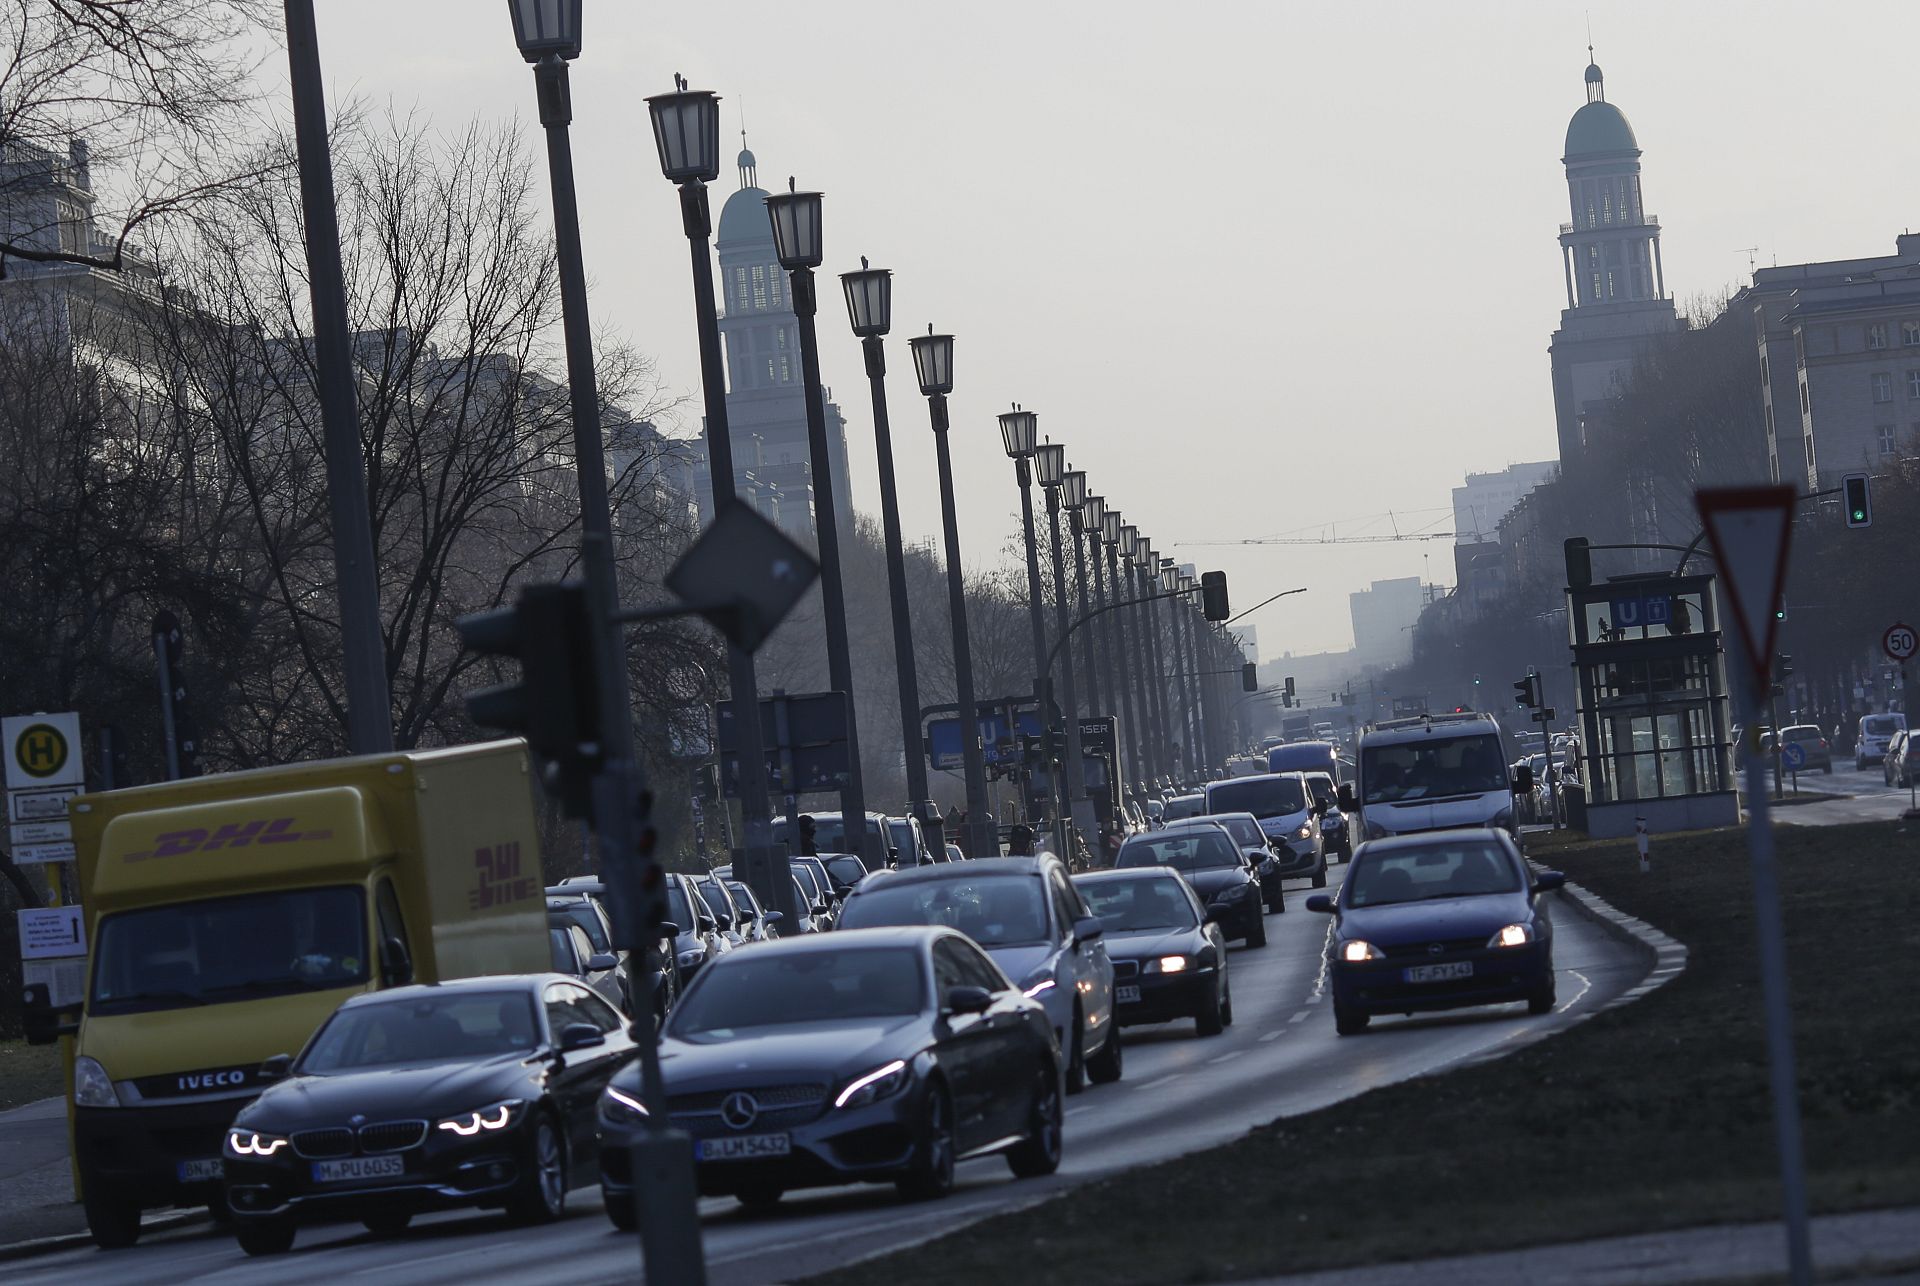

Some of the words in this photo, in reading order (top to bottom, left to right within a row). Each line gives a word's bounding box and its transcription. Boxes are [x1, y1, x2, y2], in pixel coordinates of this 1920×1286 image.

[1618, 601, 1638, 624] U
[1891, 633, 1912, 651] 50
[979, 720, 996, 745] U
[29, 735, 53, 765] H
[152, 817, 302, 858] DHL
[178, 1070, 244, 1091] IVECO
[320, 1163, 332, 1178] M
[340, 1160, 361, 1177] PU
[363, 1157, 402, 1174] 6035
